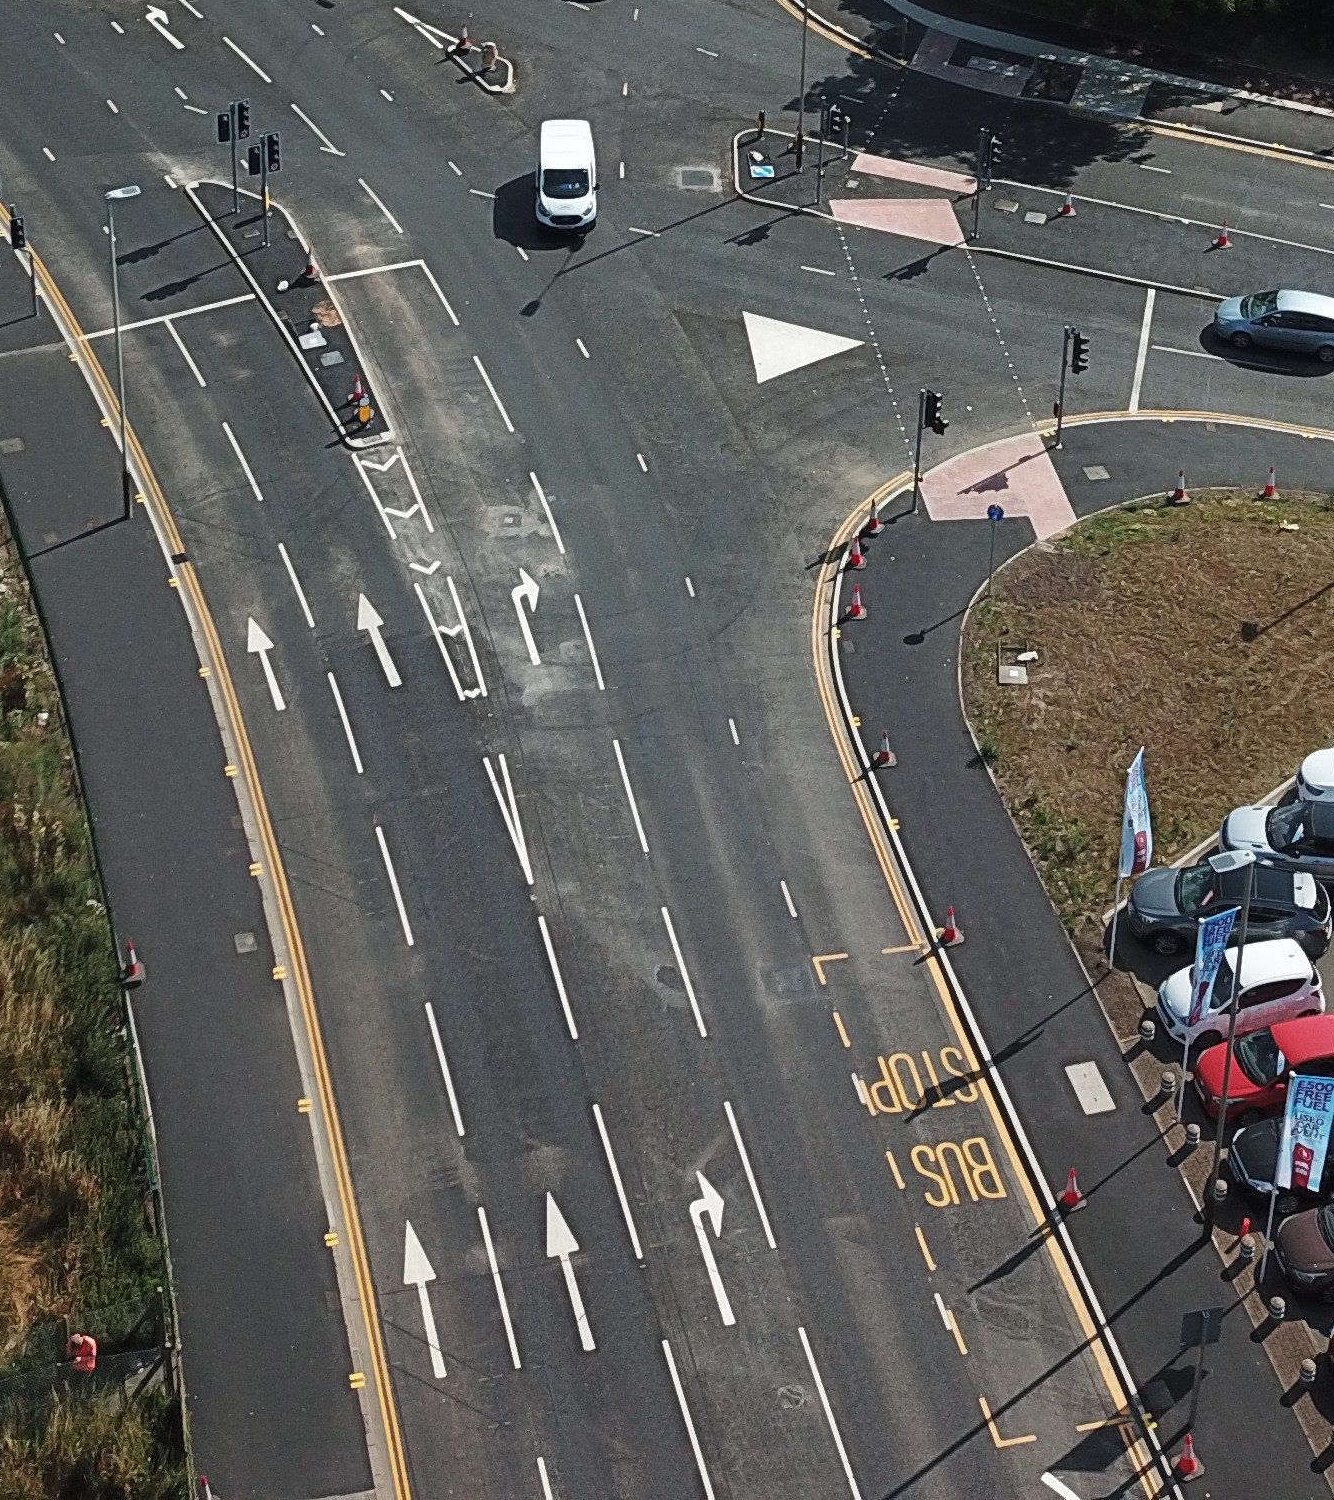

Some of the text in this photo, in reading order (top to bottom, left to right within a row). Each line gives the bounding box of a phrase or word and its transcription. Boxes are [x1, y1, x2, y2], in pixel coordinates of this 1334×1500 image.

[870, 1046, 979, 1114] STOP
[1297, 1079, 1334, 1093] £500
[1295, 1088, 1333, 1102] FREE
[1293, 1098, 1330, 1112] FUEL
[1295, 1112, 1325, 1127] USED
[910, 1136, 1007, 1208] BUS
